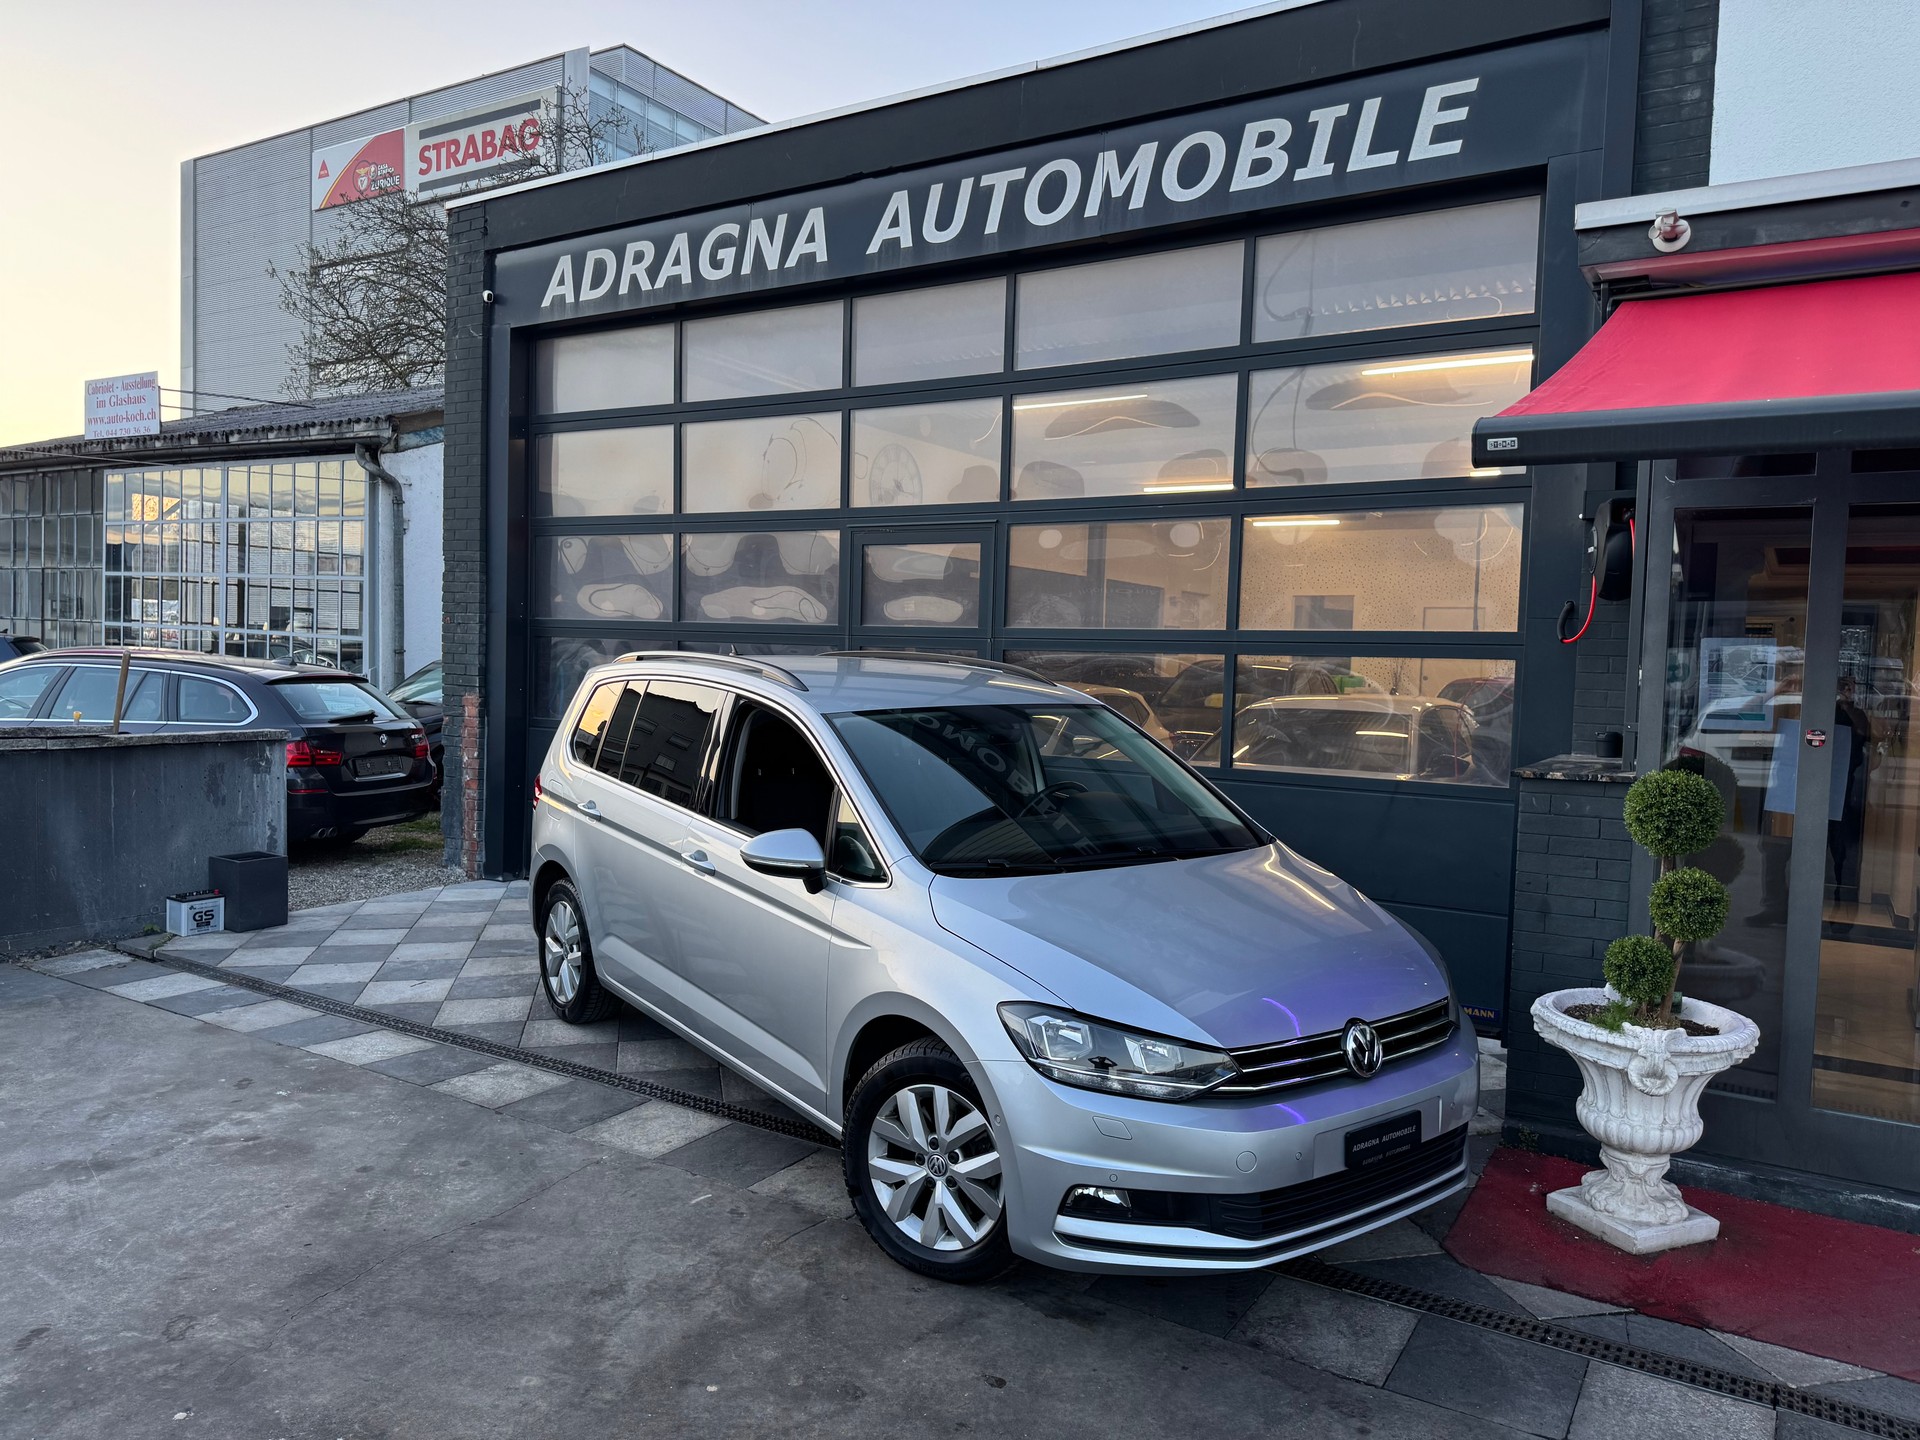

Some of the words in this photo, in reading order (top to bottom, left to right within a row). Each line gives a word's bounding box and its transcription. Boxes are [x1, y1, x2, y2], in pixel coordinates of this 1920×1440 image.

[418, 118, 541, 176] STRABAG
[541, 206, 828, 308] ADRAGNA
[865, 77, 1481, 256] AUTOMOBILE
[87, 381, 114, 396] Cabriolet
[121, 377, 156, 391] Ausstellung
[96, 397, 106, 409] im
[109, 393, 147, 407] Glashaus
[87, 408, 157, 426] www.auto-koch.ch
[192, 909, 215, 922] GS
[1352, 1137, 1380, 1153] ADRAGNA
[1381, 1124, 1417, 1143] AUTOMOBILE
